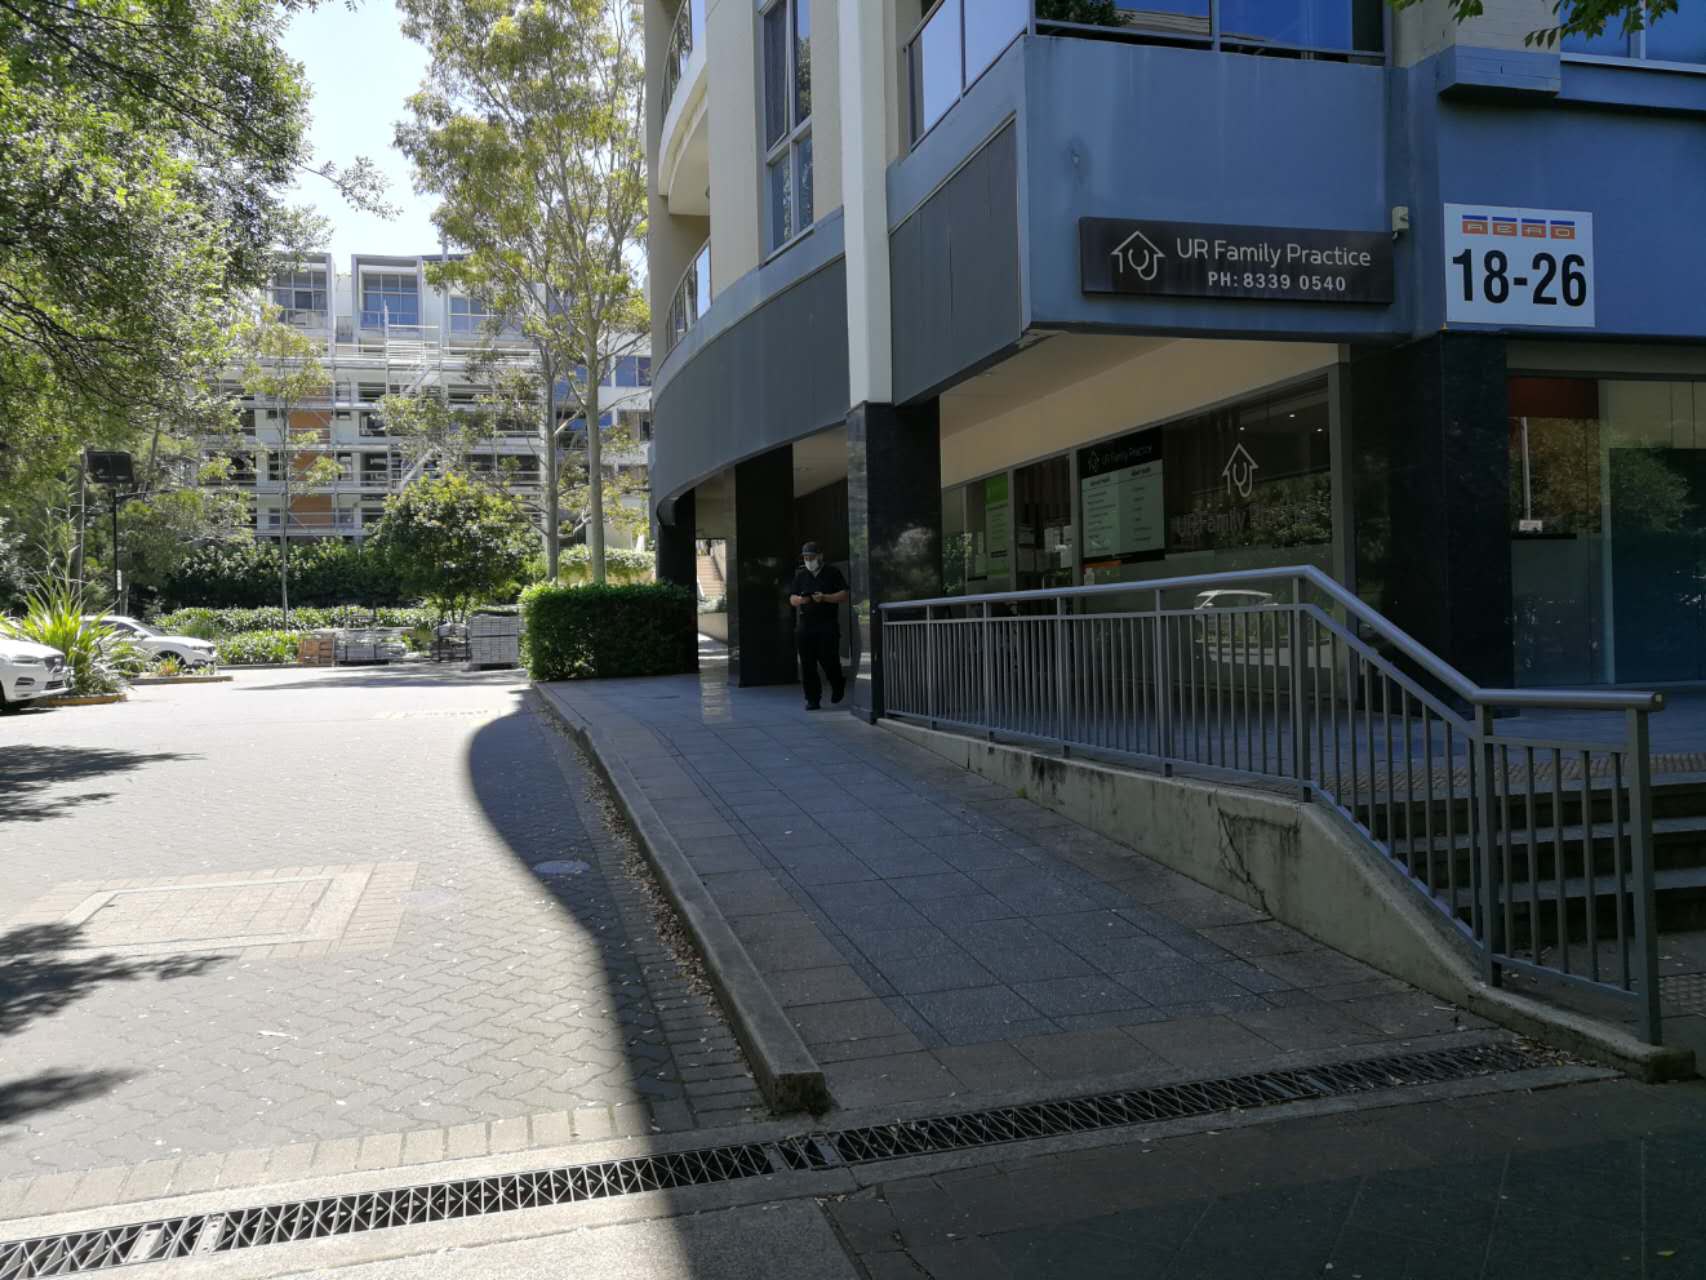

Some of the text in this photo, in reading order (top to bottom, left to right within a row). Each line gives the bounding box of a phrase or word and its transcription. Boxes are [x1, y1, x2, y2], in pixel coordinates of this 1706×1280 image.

[1176, 237, 1371, 269] UR Family Practice
[1208, 271, 1346, 292] PH: 8339 0540
[1452, 248, 1587, 308] 18-26
